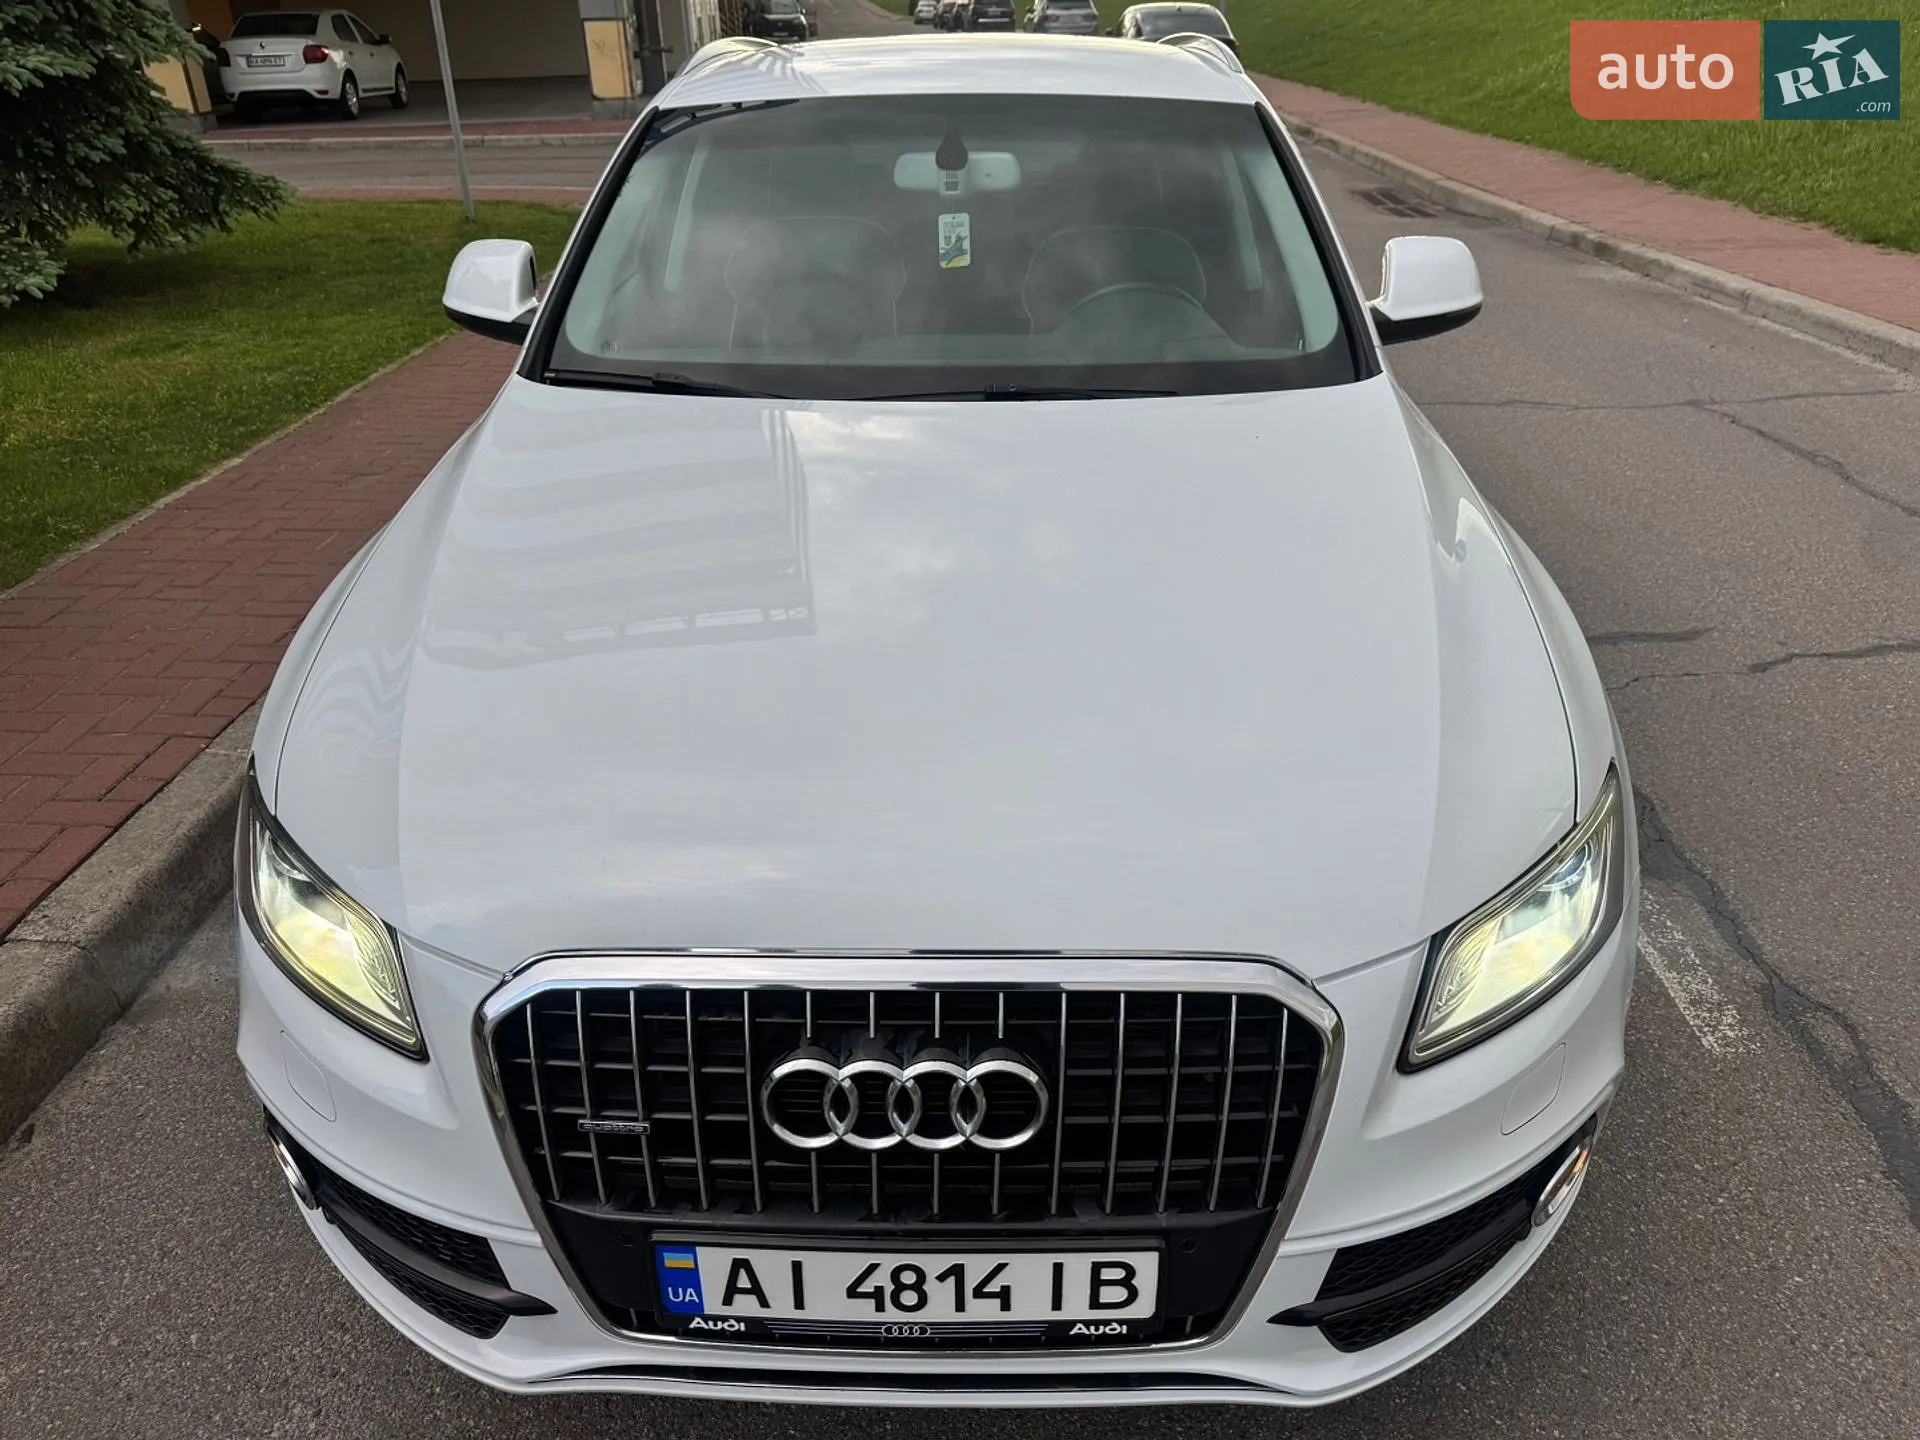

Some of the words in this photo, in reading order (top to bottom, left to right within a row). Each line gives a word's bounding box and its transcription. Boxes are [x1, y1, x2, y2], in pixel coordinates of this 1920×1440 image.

[722, 1257, 806, 1311] AI
[846, 1262, 1011, 1313] 4814
[1051, 1260, 1139, 1312] IB
[667, 1287, 700, 1304] UA
[688, 1317, 746, 1332] Audi
[1069, 1322, 1128, 1336] Audi
